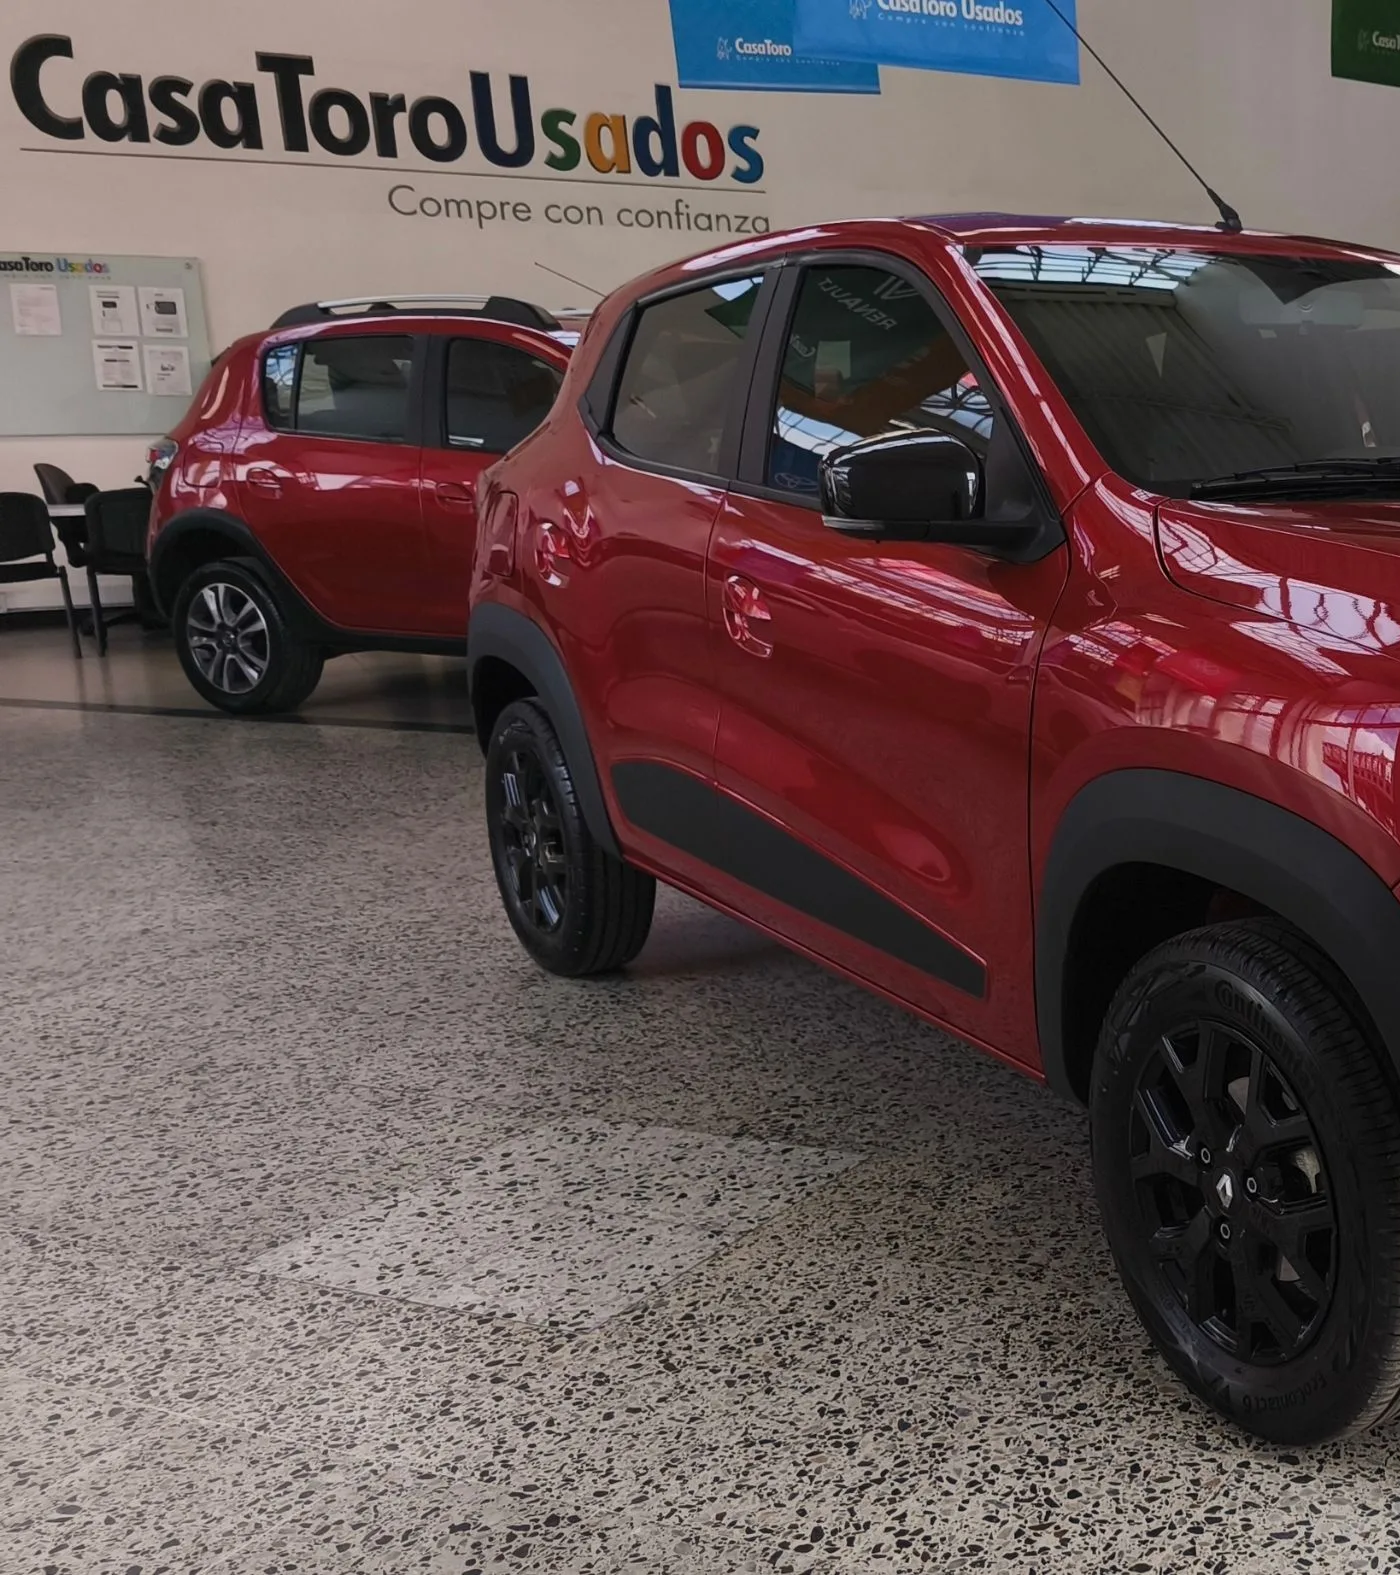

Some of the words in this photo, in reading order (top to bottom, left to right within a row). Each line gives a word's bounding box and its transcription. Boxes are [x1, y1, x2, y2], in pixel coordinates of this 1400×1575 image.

[962, 0, 1023, 26] Usados
[735, 38, 792, 56] CasaToro
[387, 183, 532, 230] Compre
[543, 201, 604, 226] con
[616, 198, 771, 235] confianza
[0, 256, 54, 272] asaToro
[55, 257, 110, 274] Usados
